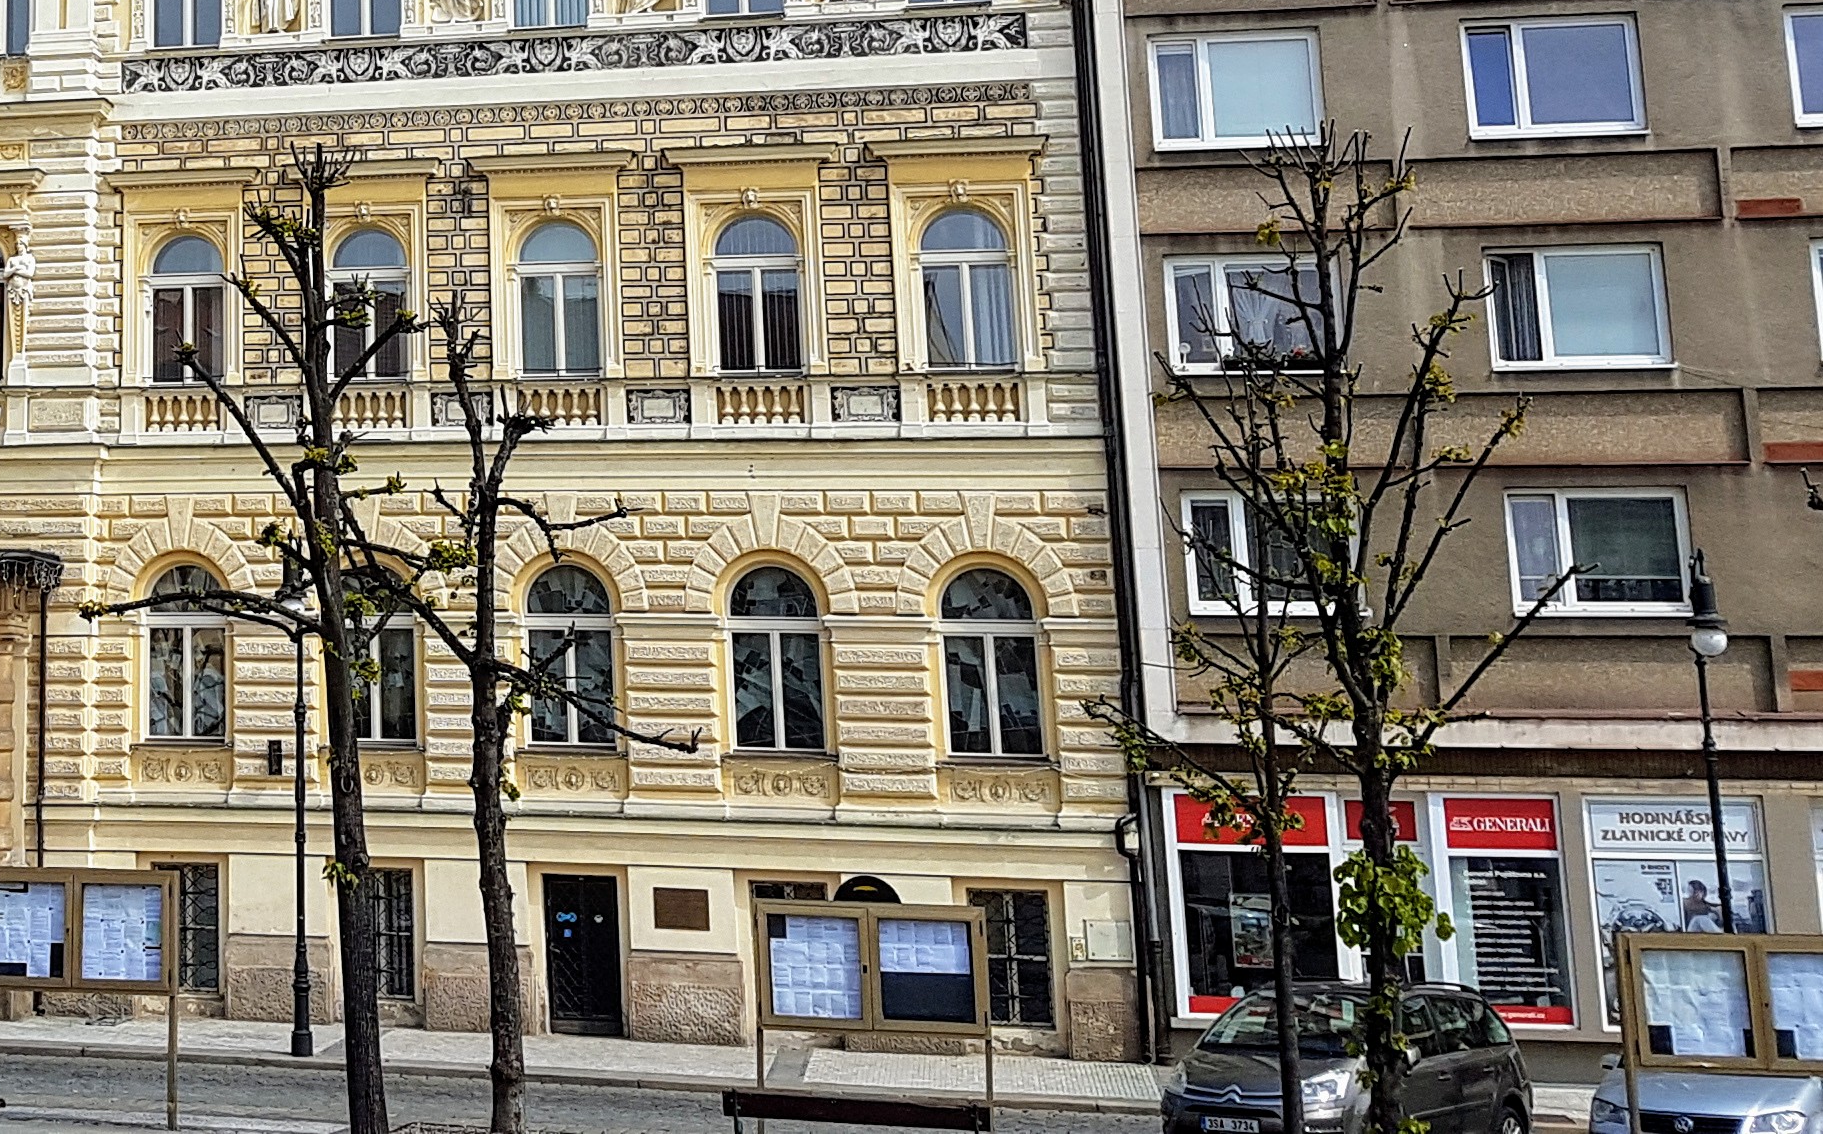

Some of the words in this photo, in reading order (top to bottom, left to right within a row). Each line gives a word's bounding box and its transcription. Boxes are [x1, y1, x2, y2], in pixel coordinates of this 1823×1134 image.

[1473, 816, 1551, 832] GENERALI
[1618, 809, 1725, 825] HODINÁŘSK
[1601, 827, 1686, 842] ZLATNICKÉ
[1231, 1119, 1255, 1132] 3734
